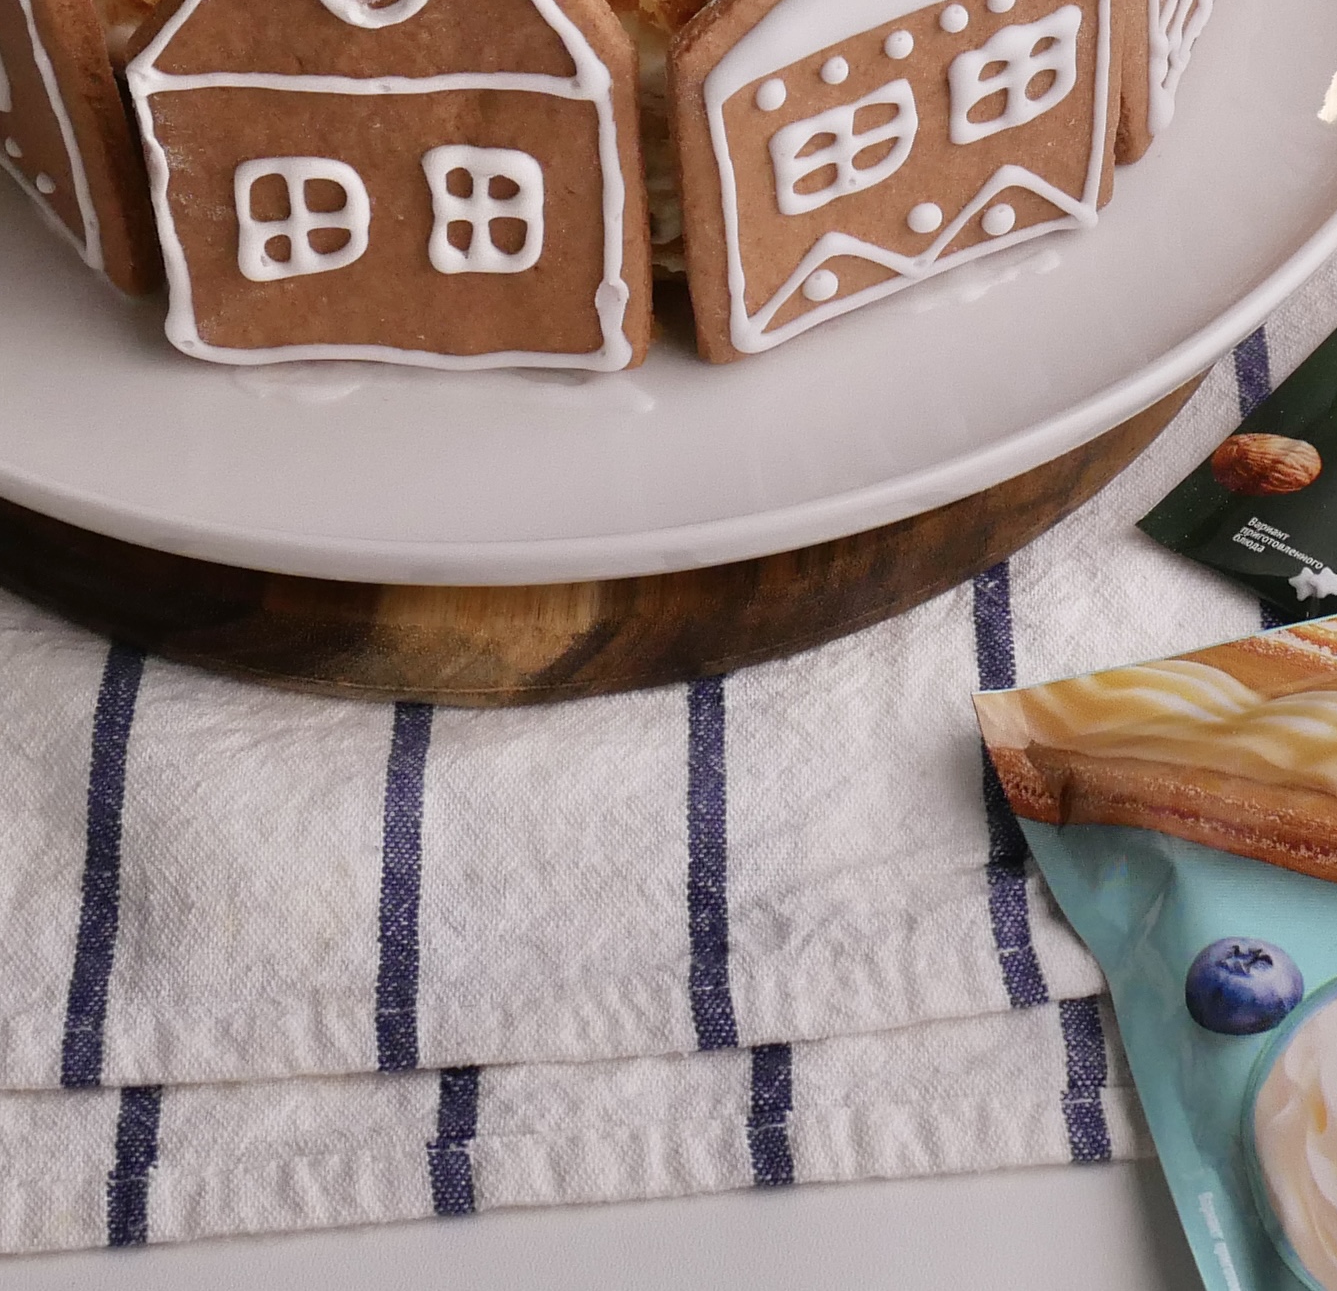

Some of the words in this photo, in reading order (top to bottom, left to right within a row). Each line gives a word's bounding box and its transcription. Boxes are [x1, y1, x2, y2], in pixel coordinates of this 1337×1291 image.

[1247, 516, 1290, 541] Вариант
[1232, 533, 1266, 553] блюда
[1239, 526, 1324, 570] приготовленного
